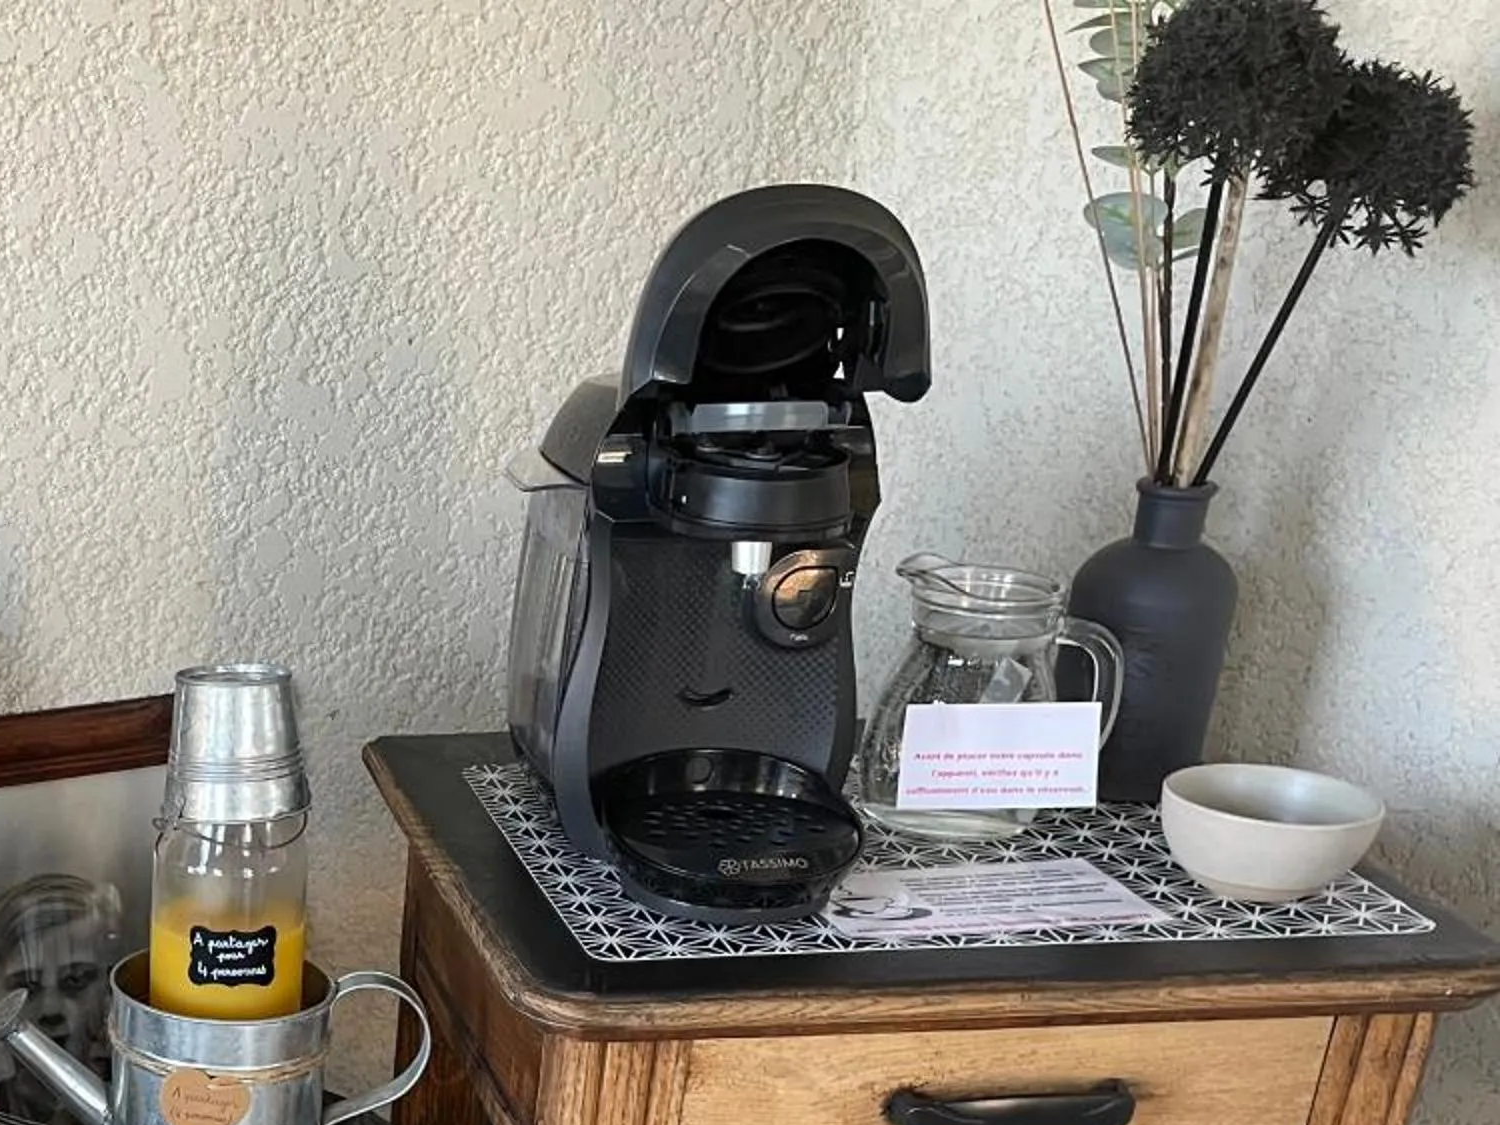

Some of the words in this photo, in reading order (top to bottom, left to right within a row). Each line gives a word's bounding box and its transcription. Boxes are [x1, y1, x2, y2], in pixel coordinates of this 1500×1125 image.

[741, 857, 808, 871] TASSIMO
[207, 935, 269, 955] partager
[215, 951, 246, 963] pour
[197, 961, 208, 977] 4
